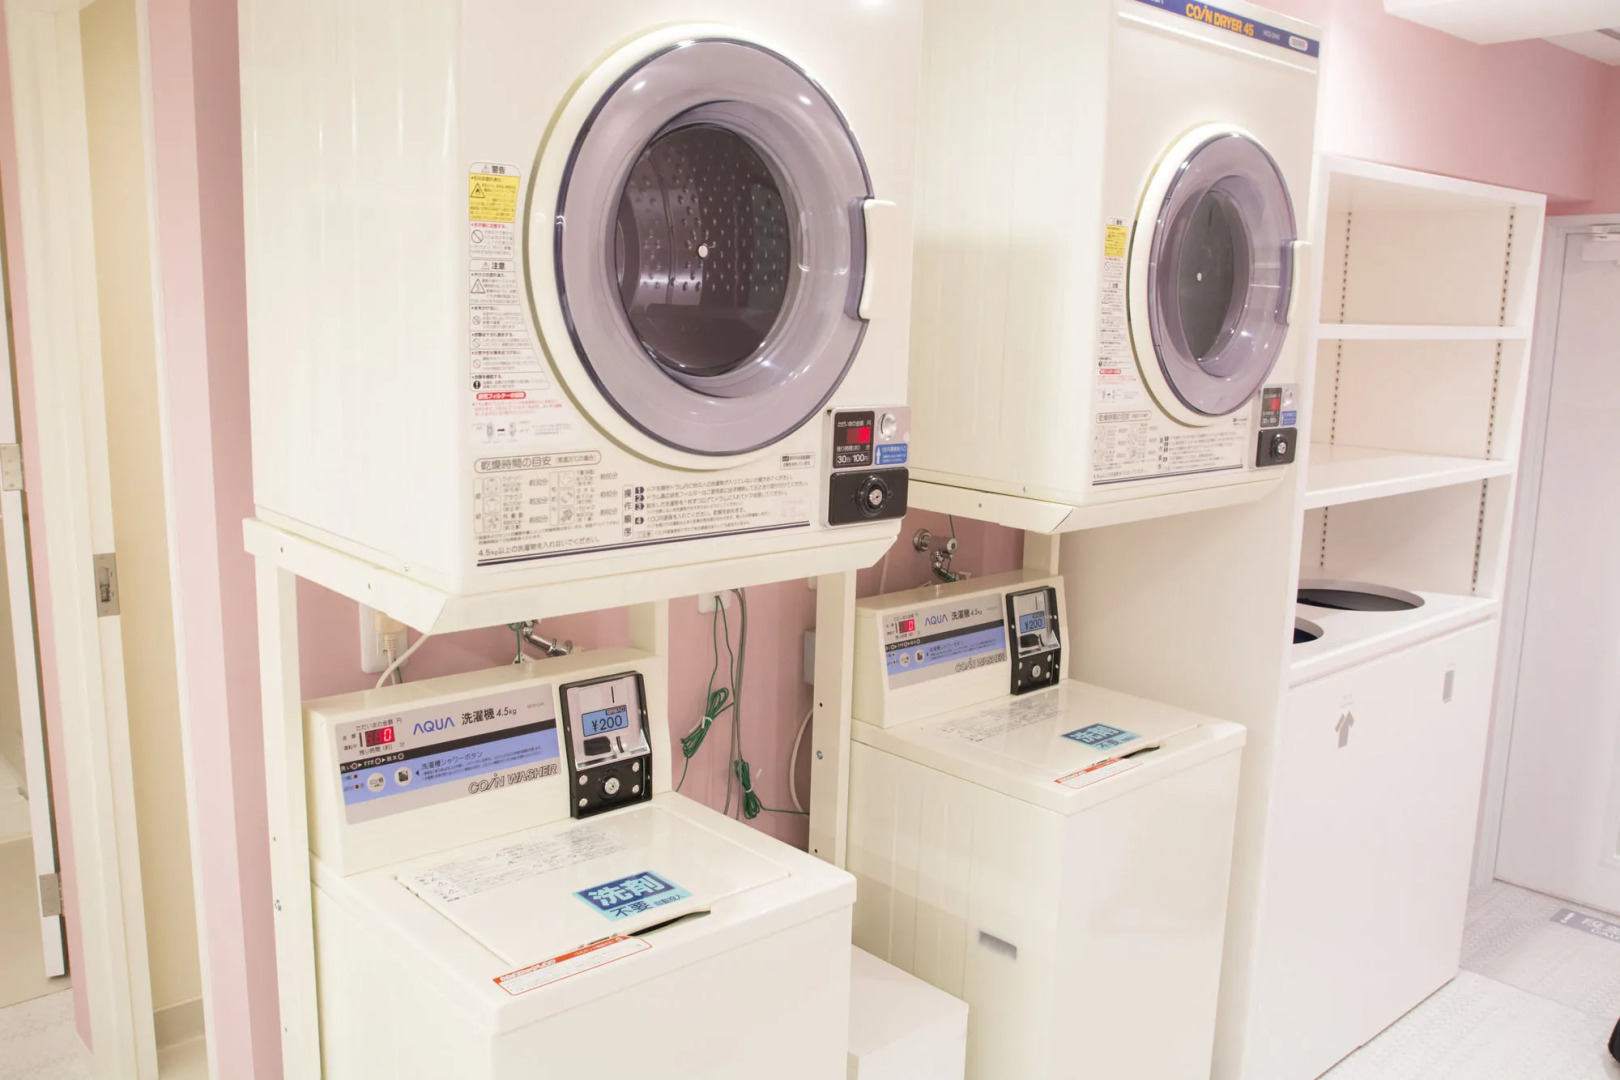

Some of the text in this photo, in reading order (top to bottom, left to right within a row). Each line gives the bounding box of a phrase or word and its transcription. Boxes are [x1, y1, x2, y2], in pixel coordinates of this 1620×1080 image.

[1186, 3, 1255, 36] COIN DRYER 45
[491, 262, 505, 270] 注意
[480, 457, 551, 471] 乾燥時間の目安
[623, 488, 632, 537] 操作順序
[924, 613, 948, 627] AQUA
[951, 609, 970, 621] 洗濯機
[908, 620, 913, 631] 0
[1024, 618, 1043, 631] ¥200
[955, 653, 1007, 673] COIN WASHER
[461, 706, 517, 725] 洗濯機 4.5kg
[591, 714, 623, 732] ¥200
[355, 718, 394, 731] ただいまの金額
[413, 716, 455, 735] AQUA
[383, 728, 392, 742] 0
[1070, 724, 1120, 743] 洗剤
[468, 772, 505, 794] COIN
[507, 763, 558, 785] WASHER
[587, 874, 665, 906] 洗剤
[609, 900, 653, 917] 不要
